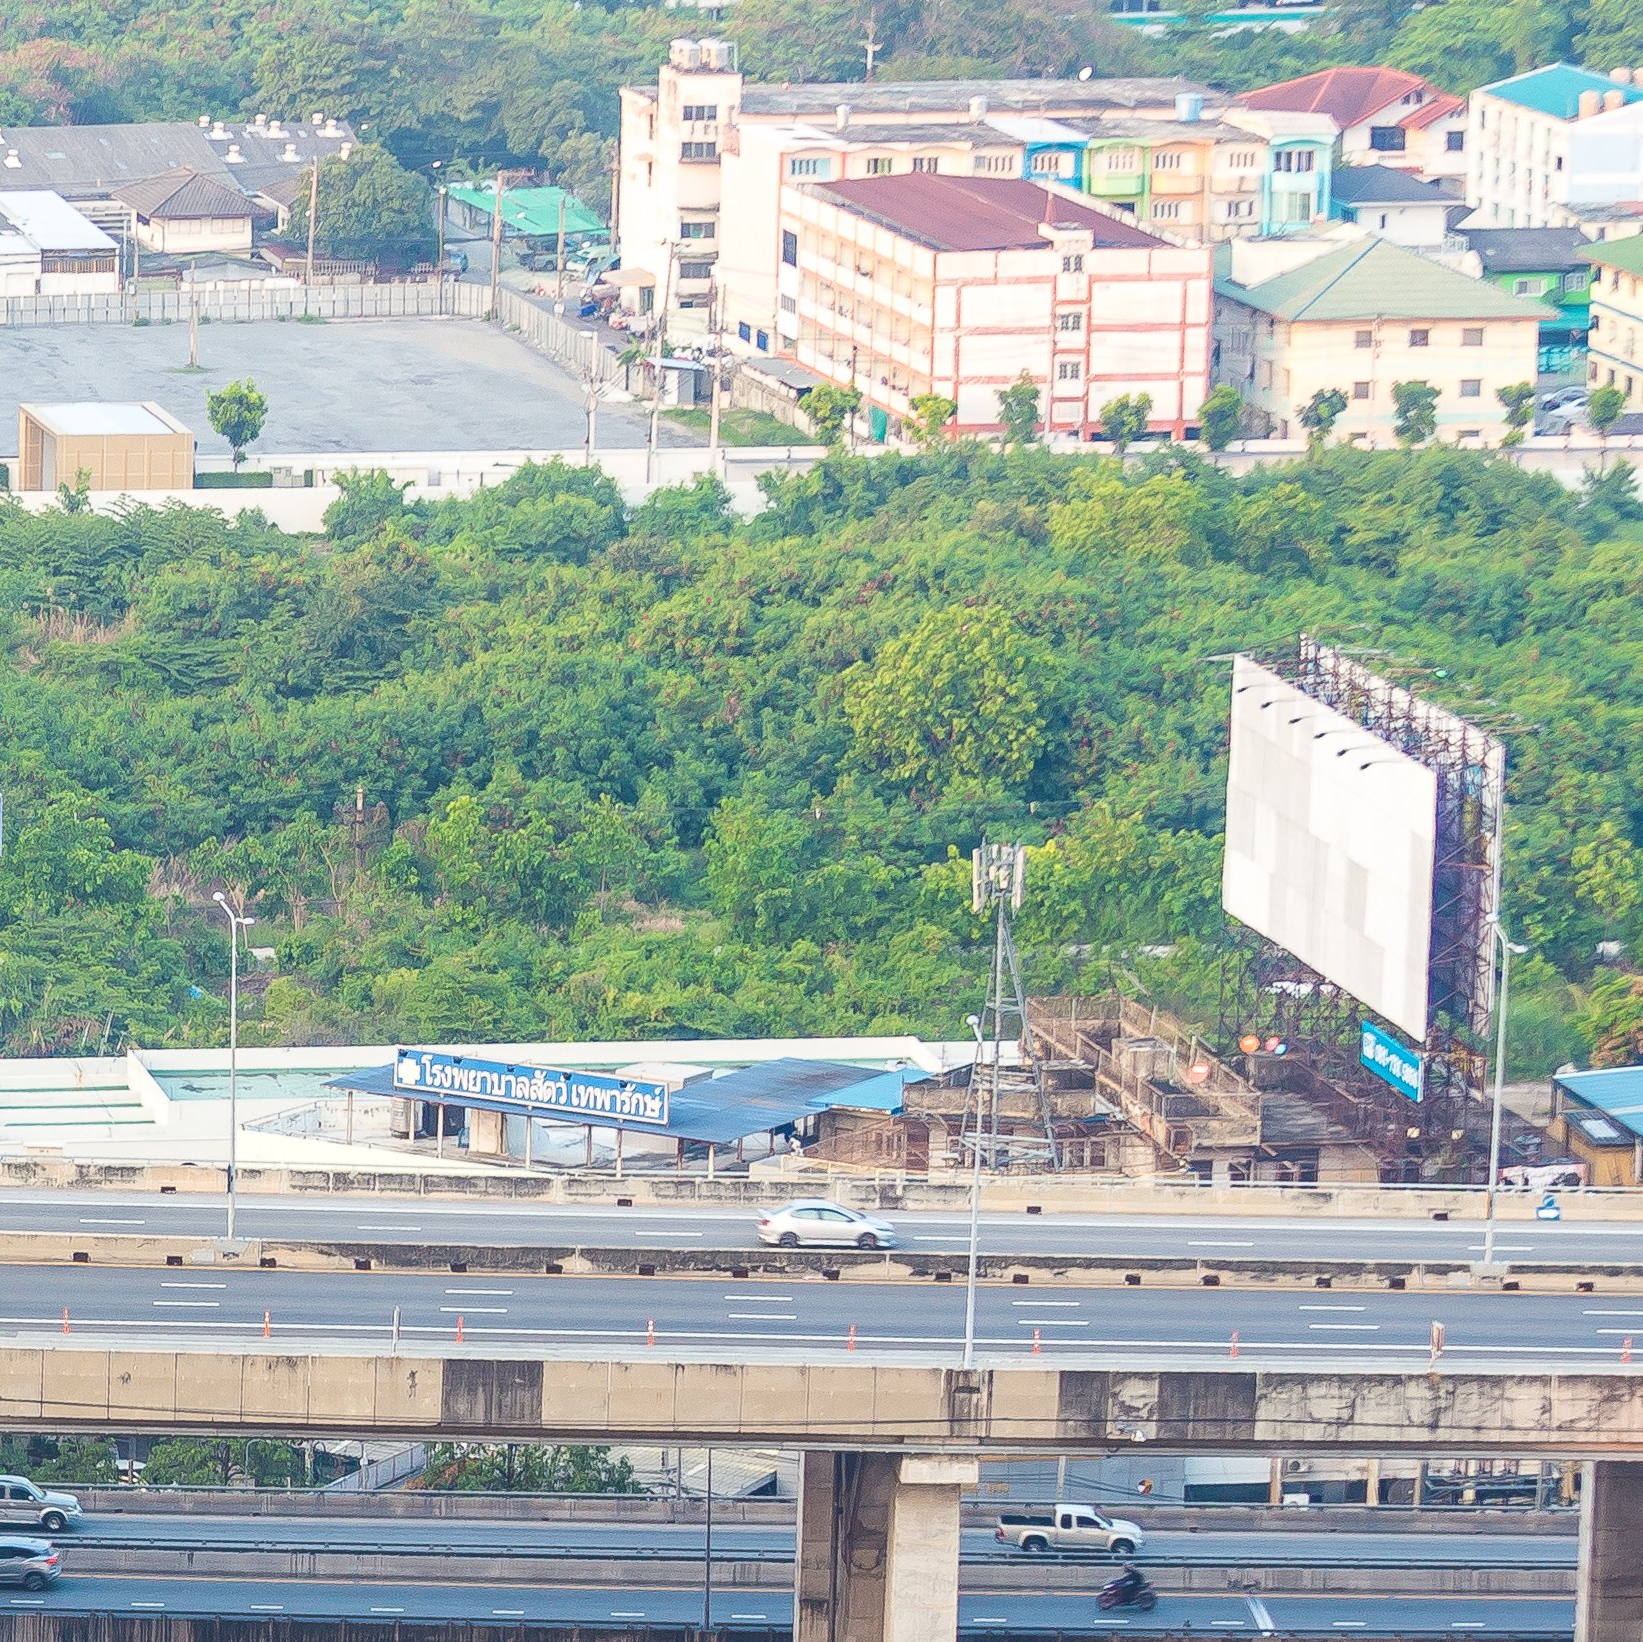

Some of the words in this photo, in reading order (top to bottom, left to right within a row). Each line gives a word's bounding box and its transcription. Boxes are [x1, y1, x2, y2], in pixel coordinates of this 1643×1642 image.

[421, 1054, 569, 1105] โรงพยาบาลสัตว์
[570, 1082, 664, 1118] เทพารักษ์
